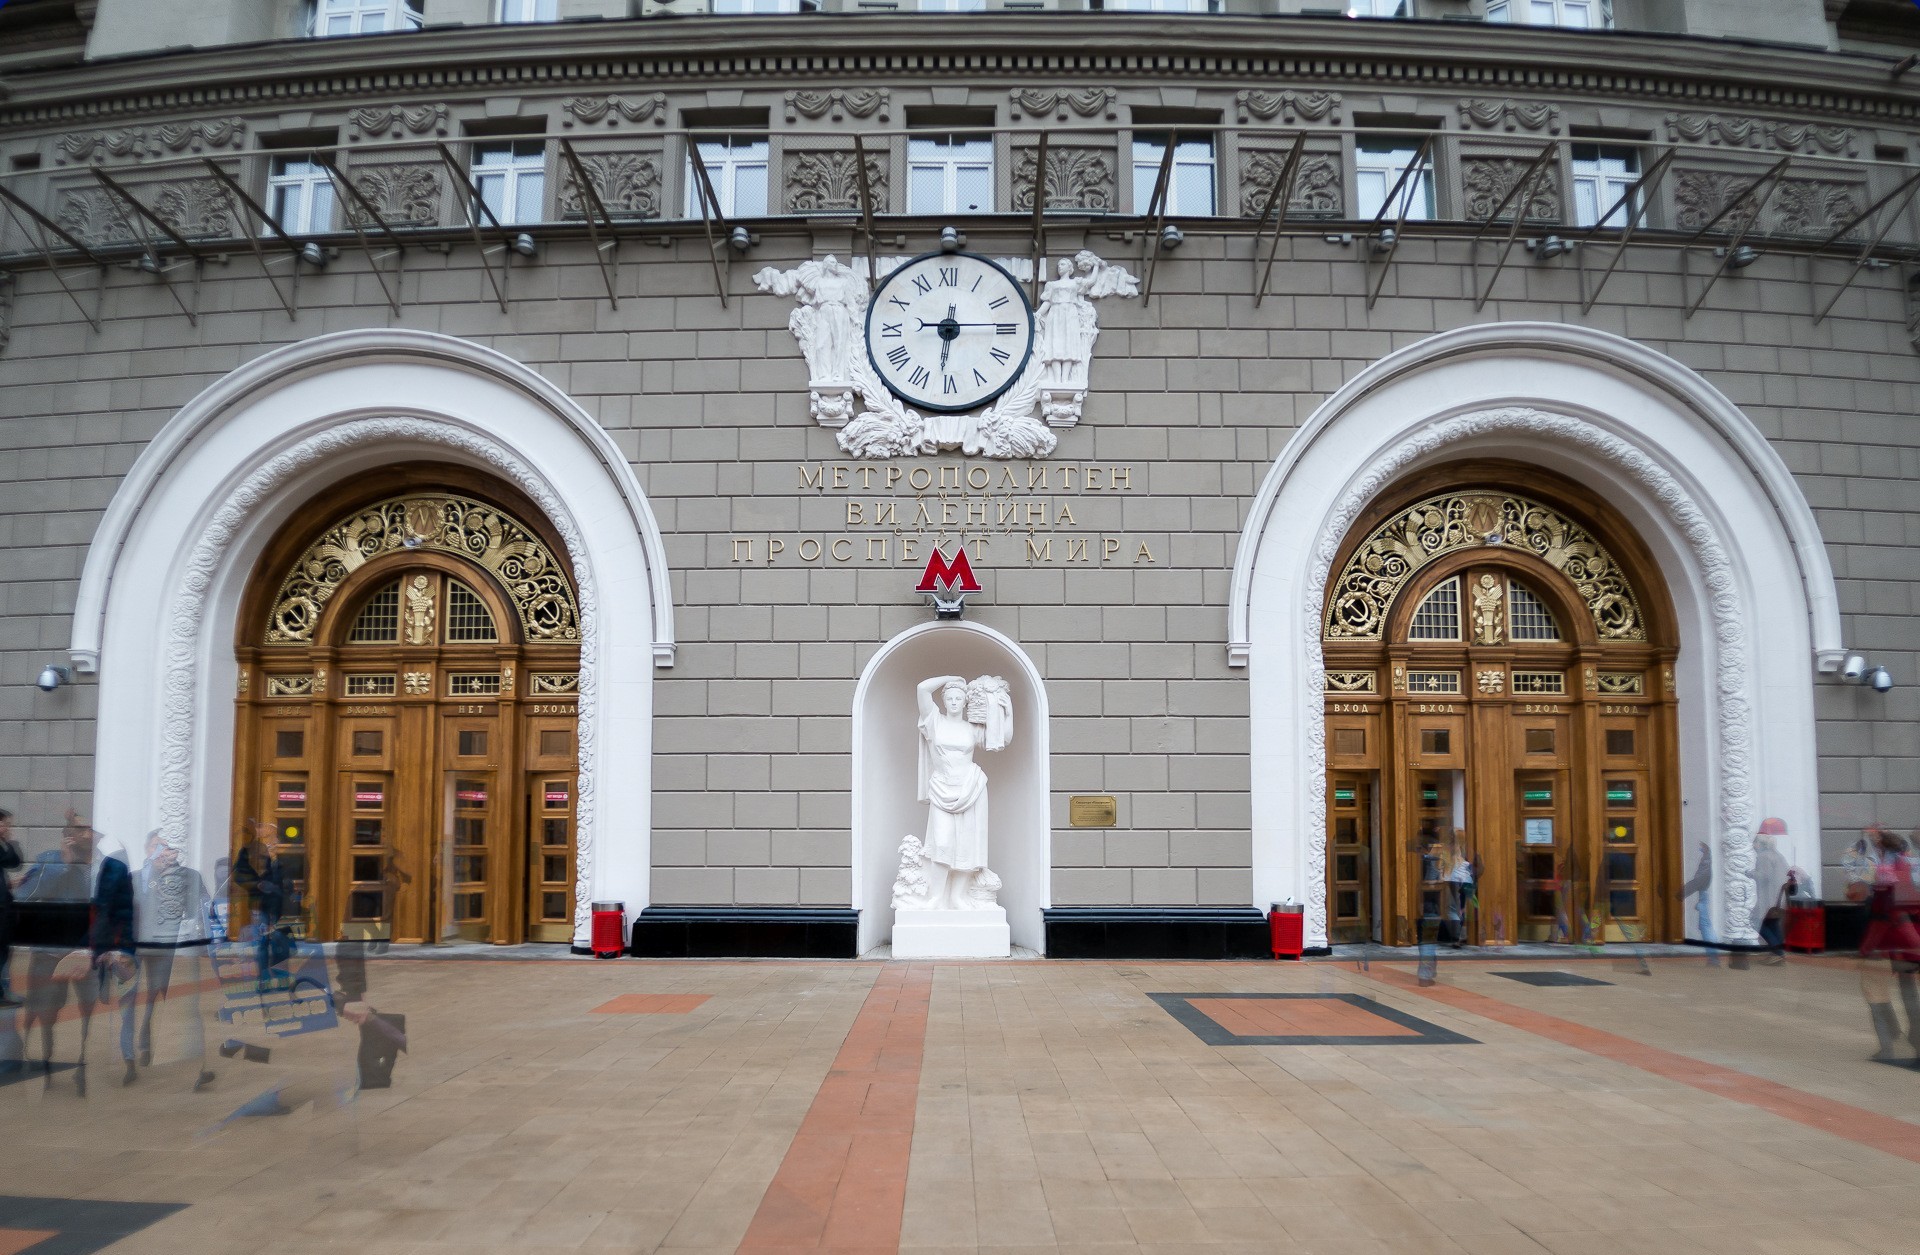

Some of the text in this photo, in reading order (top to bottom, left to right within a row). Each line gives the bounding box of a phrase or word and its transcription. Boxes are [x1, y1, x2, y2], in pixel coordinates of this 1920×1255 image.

[912, 274, 932, 296] XI
[939, 268, 958, 286] XII
[889, 295, 910, 311] X
[882, 323, 902, 337] IX
[886, 346, 911, 371] VIII
[990, 347, 1010, 365] IV
[908, 366, 930, 389] VII
[944, 375, 957, 393] VI
[973, 368, 987, 386] V
[797, 466, 1133, 490] МЕТРОПОЛИТЕН
[915, 492, 1013, 501] ИМЕНИ
[911, 502, 1077, 526] ЛЕНИНА
[894, 527, 1037, 537] СТАНЦИЯ
[732, 537, 1156, 564] ПРОСПЕКТ МИРА
[914, 545, 983, 592] М
[277, 705, 388, 715] НЕТ ВХОДА
[458, 705, 576, 714] НЕТ ВХОДА
[1334, 704, 1369, 712] ВХОД
[1420, 704, 1454, 713] ВХОД
[1525, 704, 1559, 713] ВХОД
[1606, 705, 1639, 714] ВХОД
